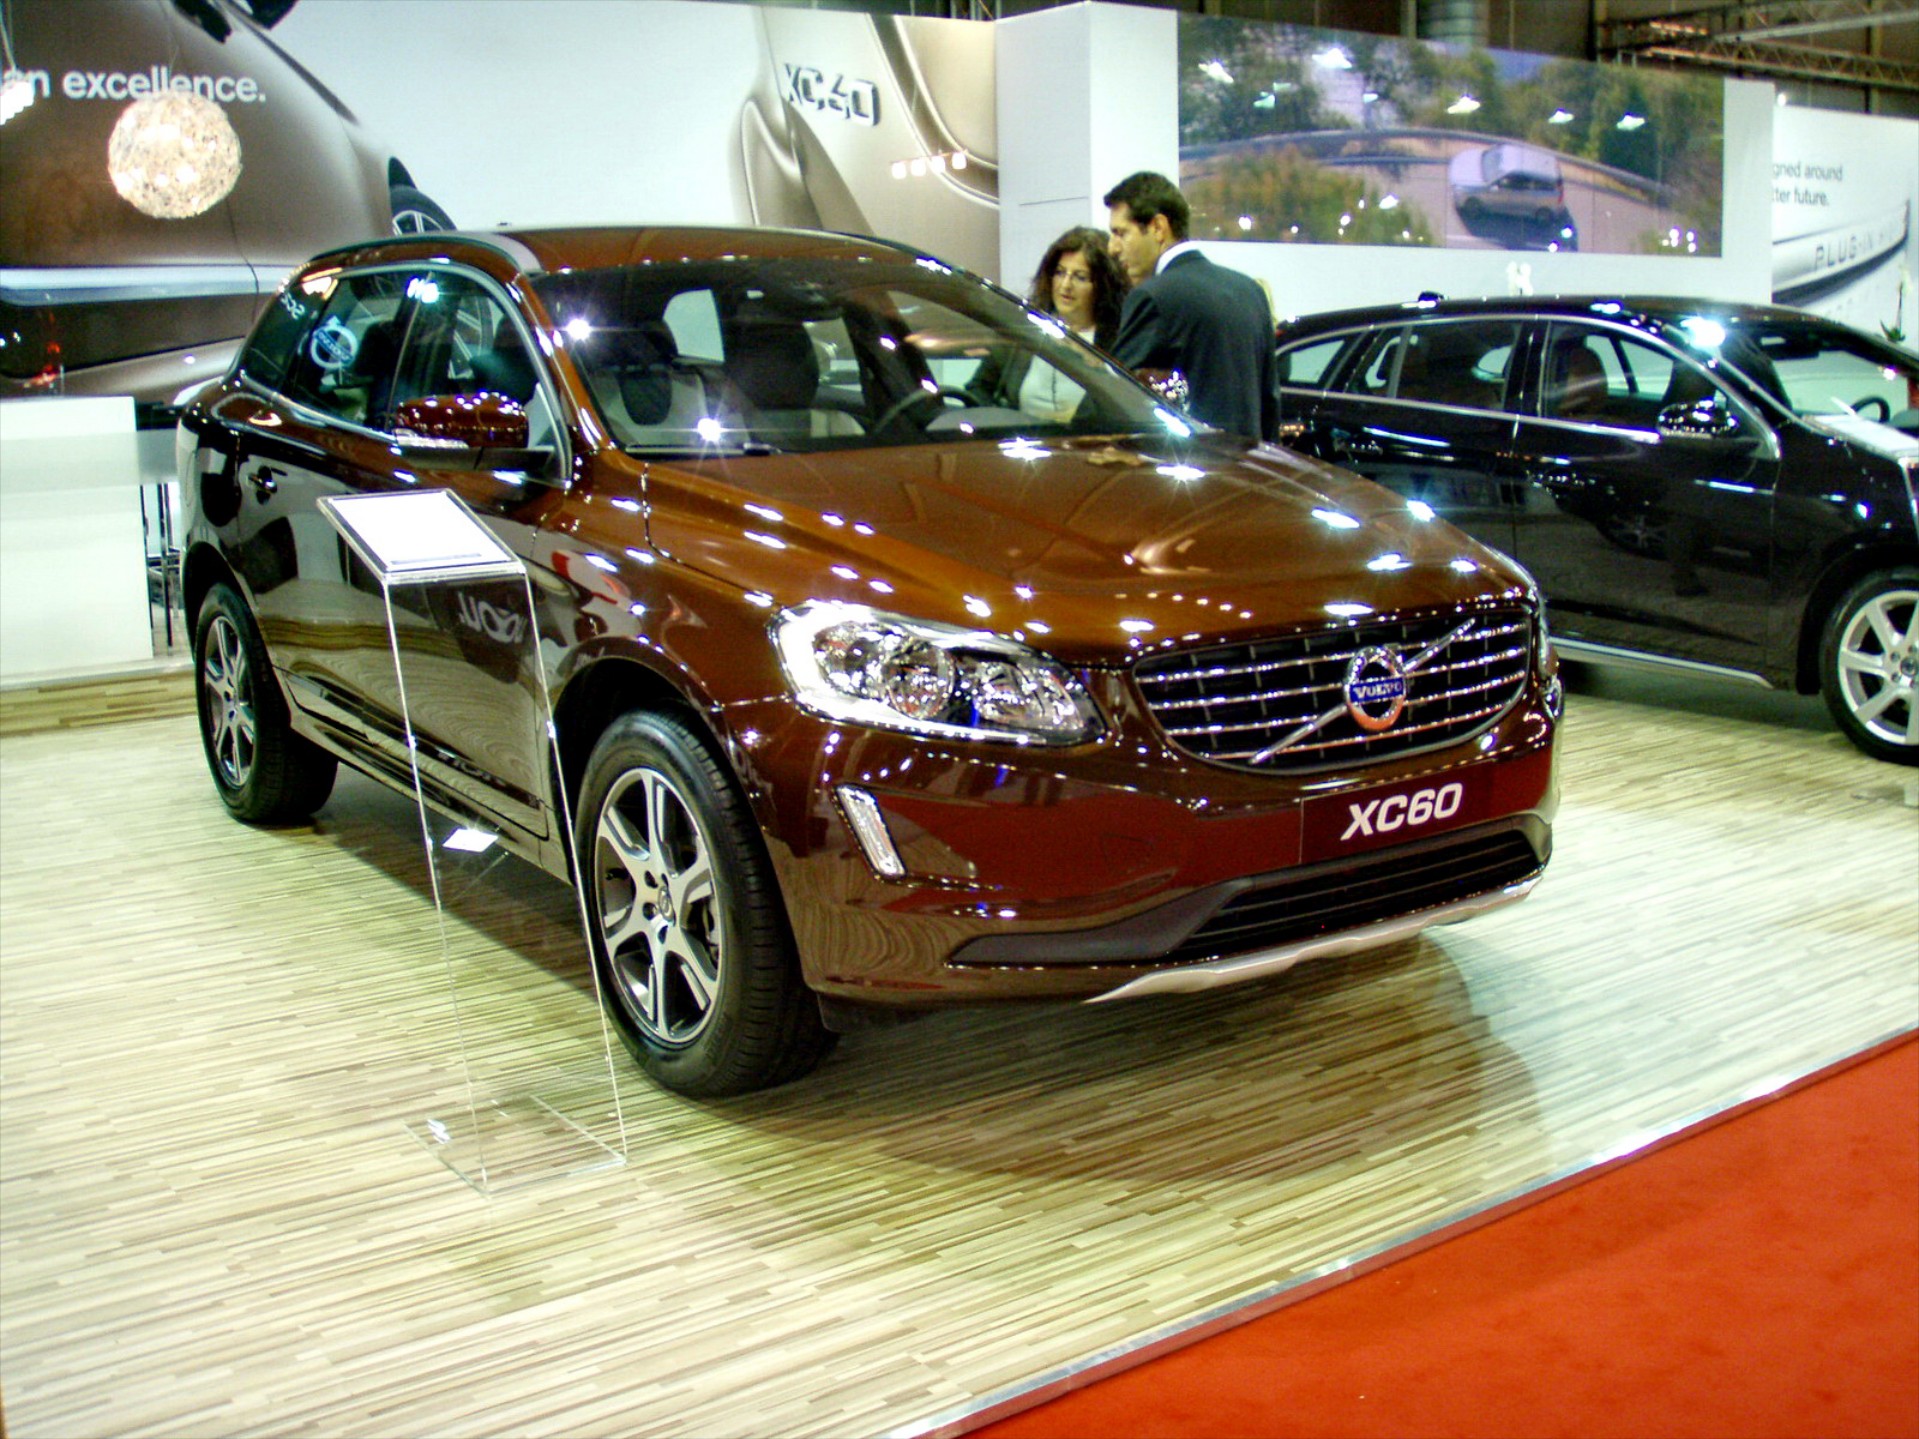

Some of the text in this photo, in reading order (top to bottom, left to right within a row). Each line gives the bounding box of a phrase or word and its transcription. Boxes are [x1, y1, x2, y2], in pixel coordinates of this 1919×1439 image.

[62, 64, 267, 103] excellence.
[1805, 164, 1844, 182] around
[1794, 187, 1830, 206] future.
[1352, 681, 1403, 699] VOLVO
[1340, 782, 1463, 841] XC60
